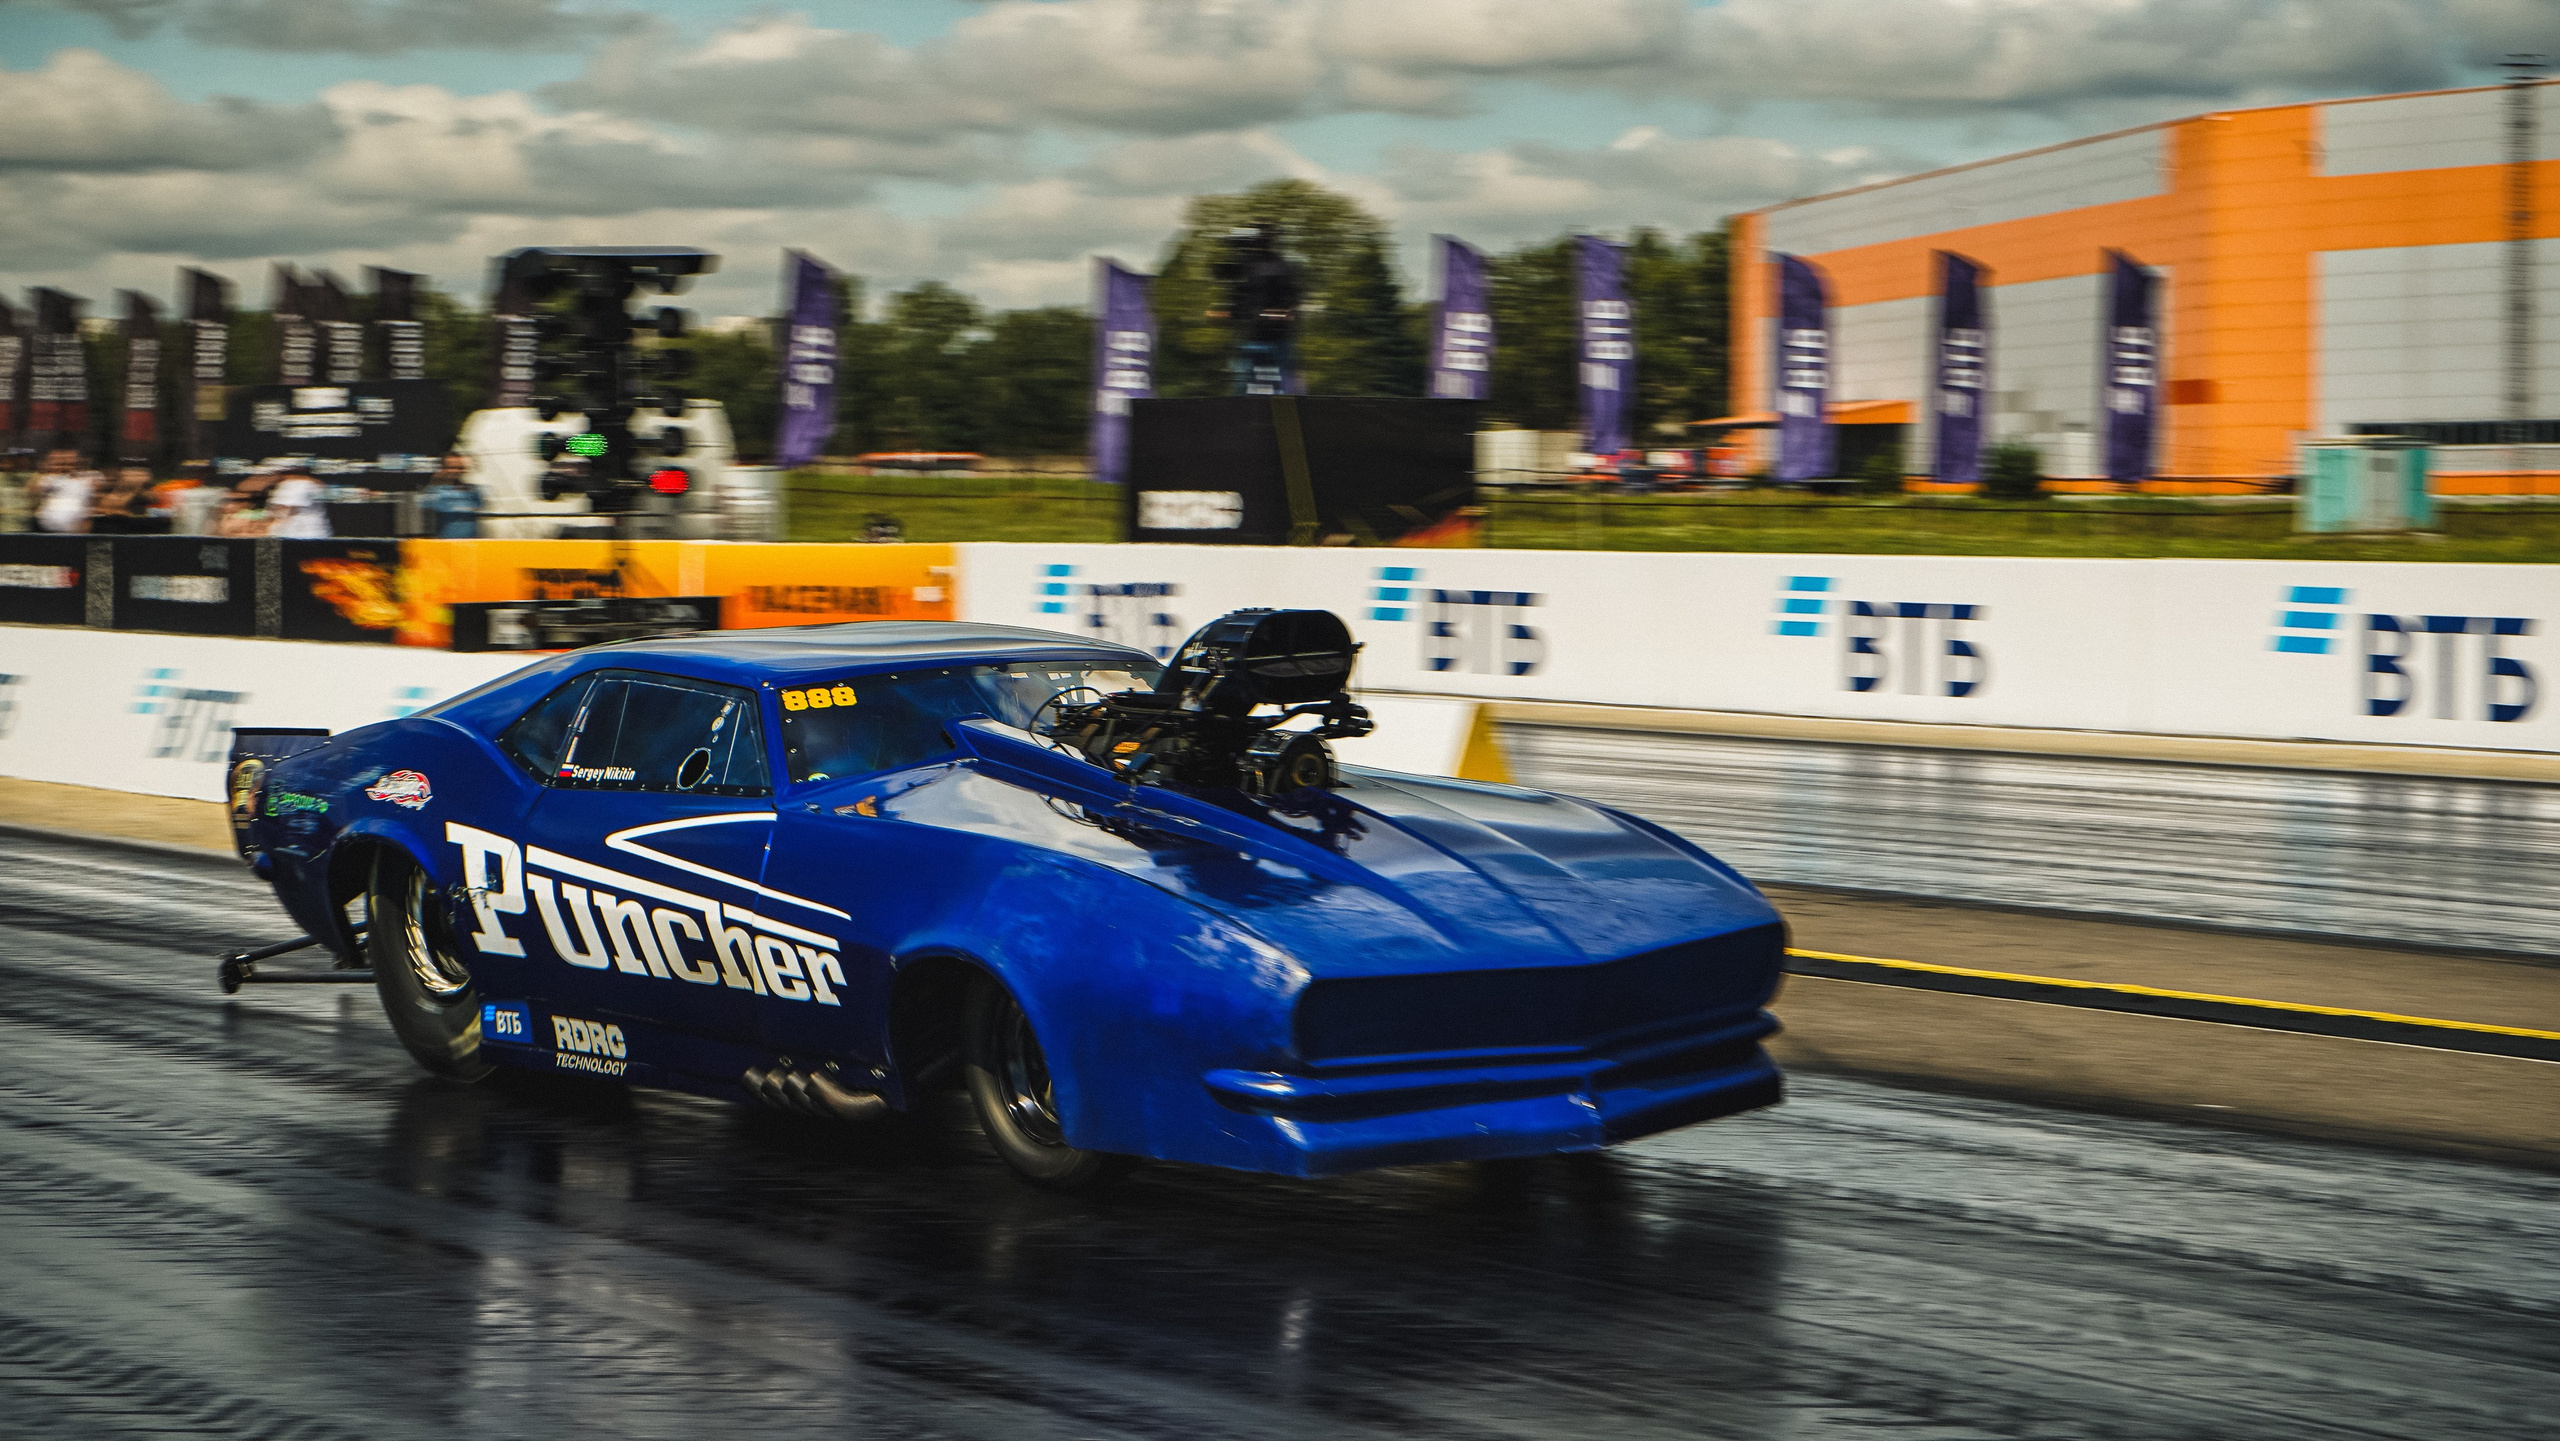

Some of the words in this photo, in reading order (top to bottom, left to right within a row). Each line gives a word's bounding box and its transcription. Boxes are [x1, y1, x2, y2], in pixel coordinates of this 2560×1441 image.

[1421, 588, 1549, 676] ВТБ
[1844, 599, 1992, 699] ВТБ
[2358, 613, 2545, 724] ВТБ
[782, 686, 858, 712] 888
[571, 764, 604, 782] Sergey
[603, 766, 637, 781] Nikitin
[445, 821, 848, 1007] Puncher
[495, 1010, 523, 1035] ВТБ
[551, 1015, 627, 1059] RDRC
[555, 1053, 627, 1076] TECHNOLOGY
